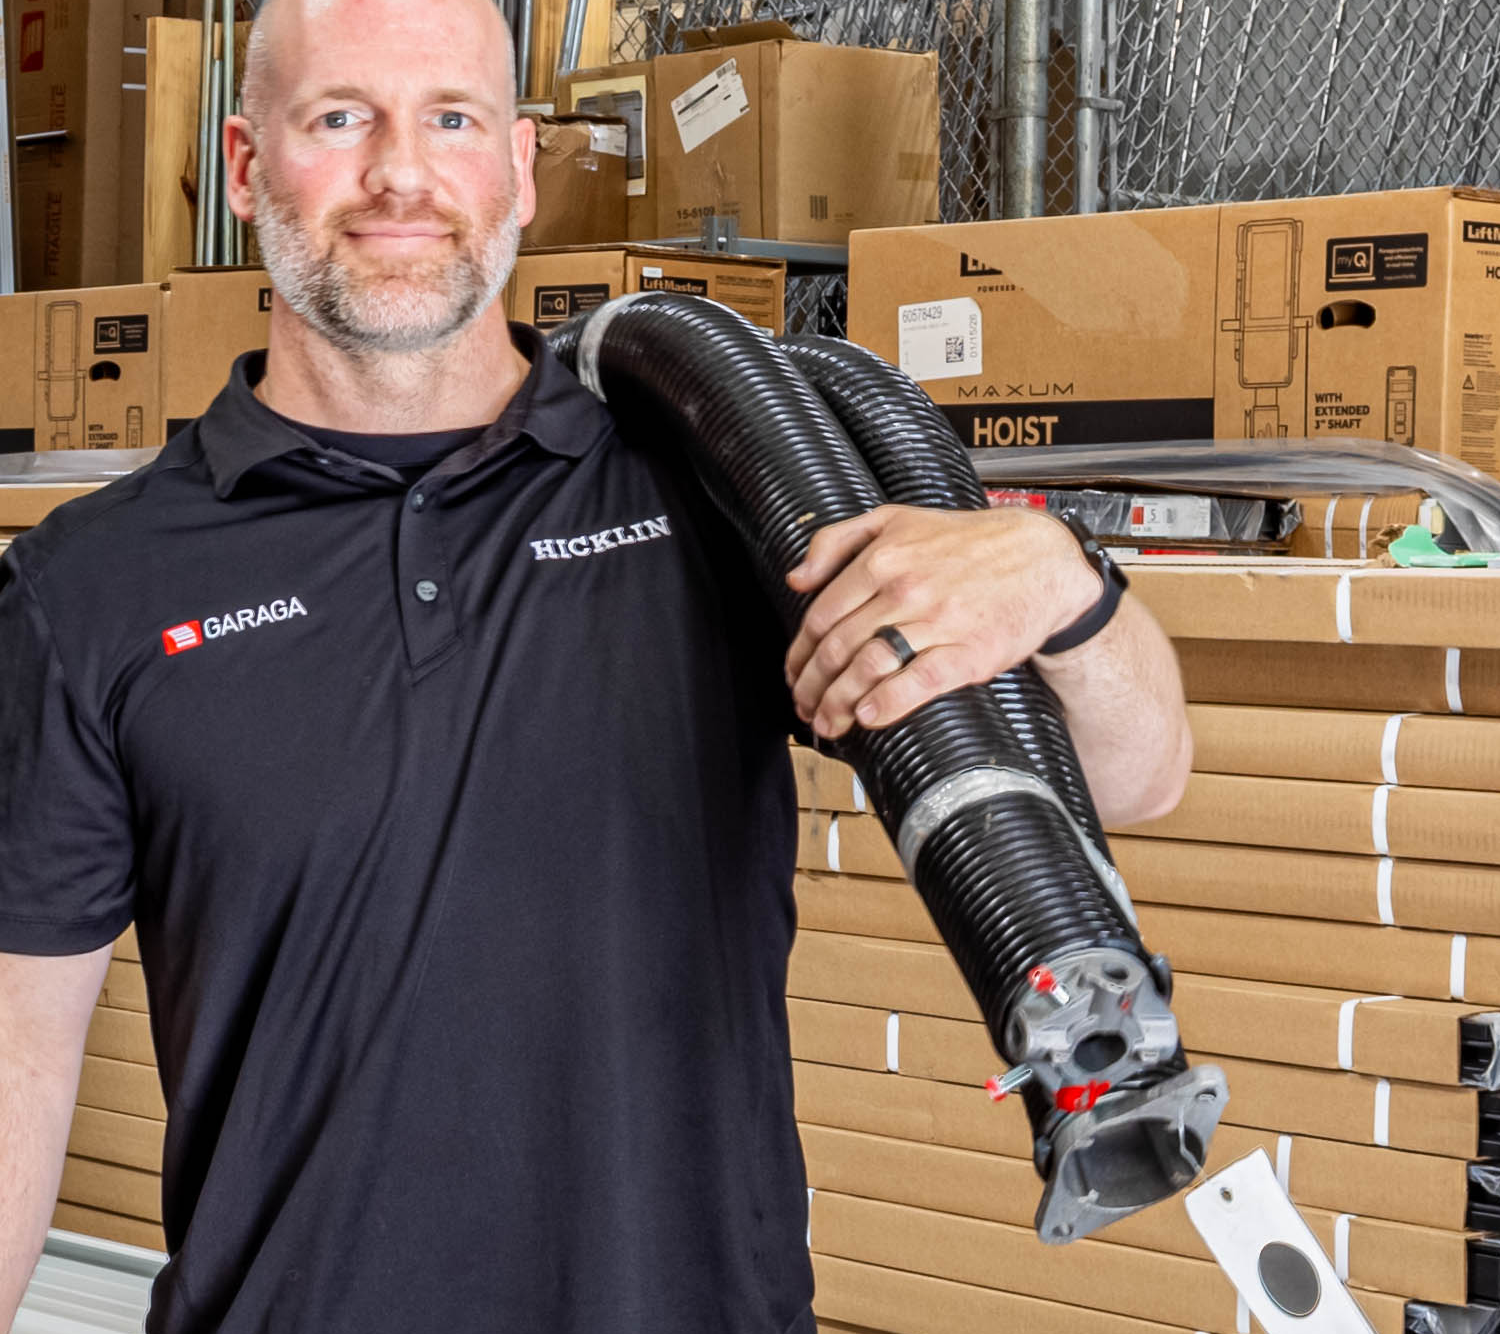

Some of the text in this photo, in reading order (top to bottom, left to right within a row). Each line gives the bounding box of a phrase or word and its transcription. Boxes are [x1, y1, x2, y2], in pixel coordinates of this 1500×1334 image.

[643, 278, 704, 293] LiftMaster
[958, 382, 1074, 398] MAXUM
[1314, 393, 1343, 404] WITH
[1314, 405, 1370, 416] EXTENDED
[973, 415, 1059, 446] HOIST
[1328, 418, 1362, 429] SHAFT
[530, 515, 674, 561] HICKLIN
[204, 596, 308, 638] GARAGA
